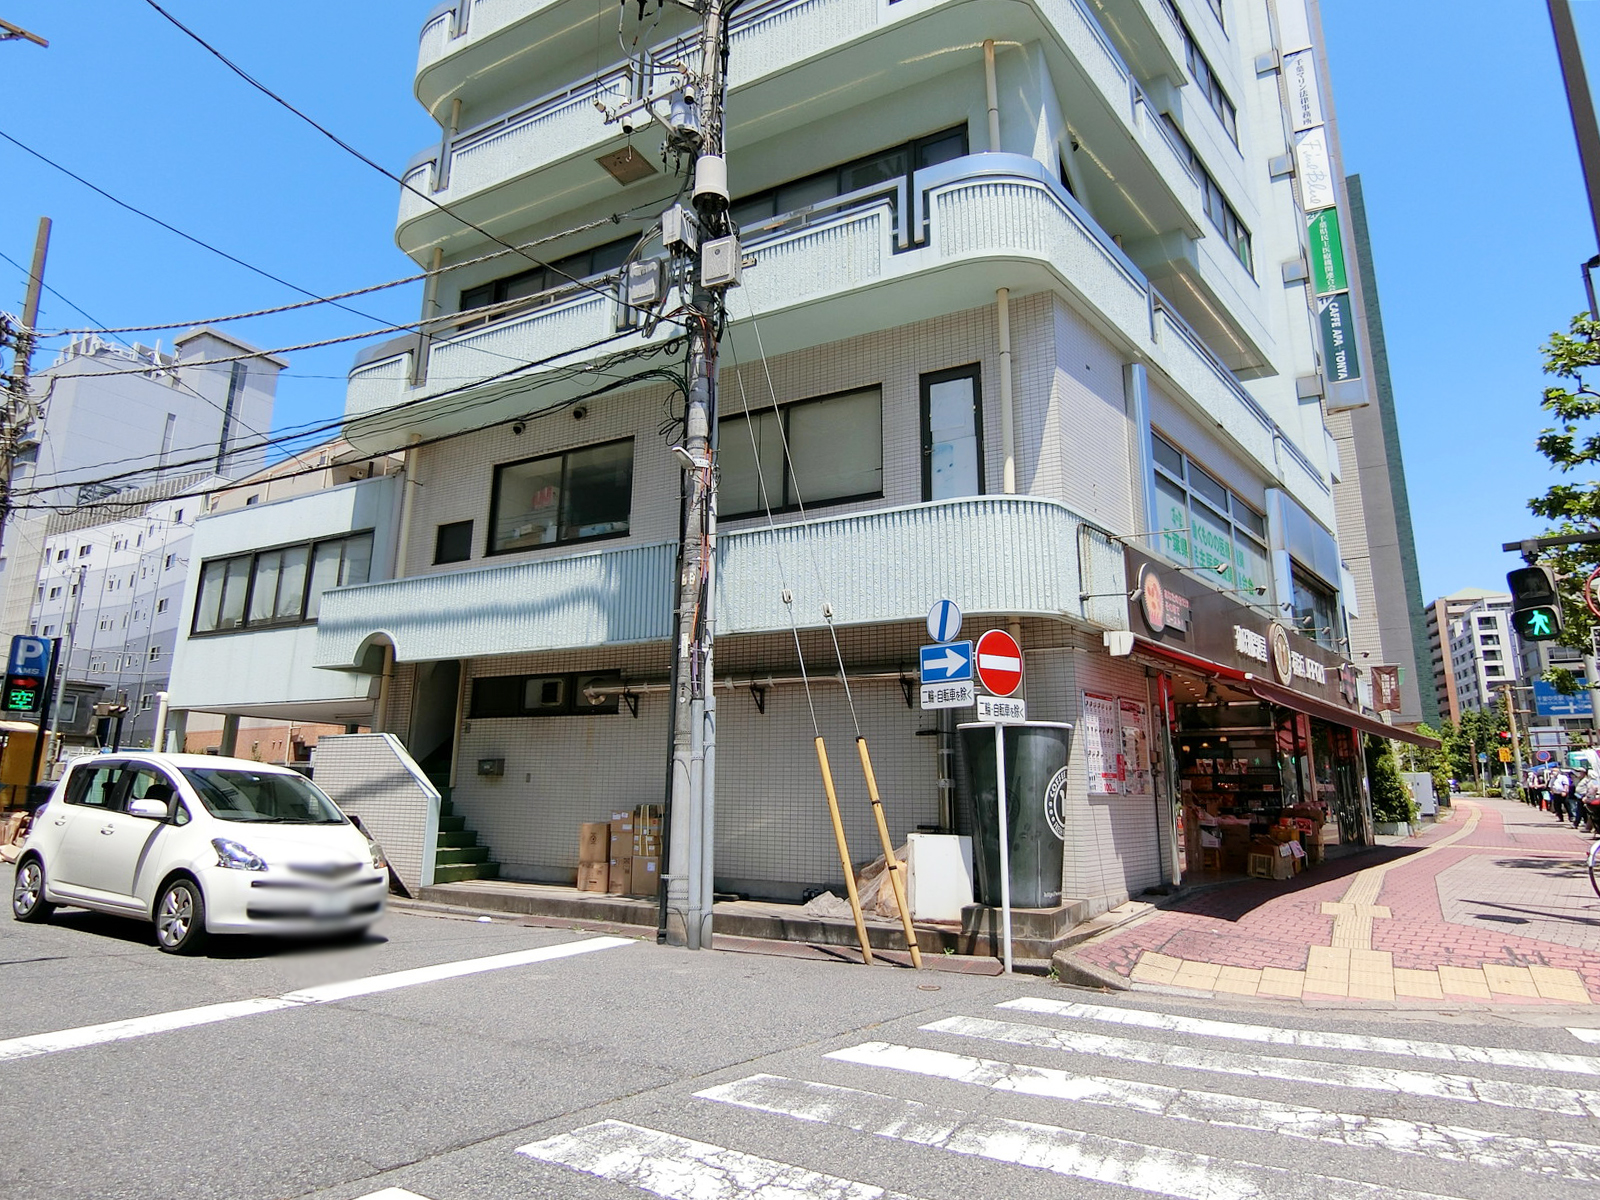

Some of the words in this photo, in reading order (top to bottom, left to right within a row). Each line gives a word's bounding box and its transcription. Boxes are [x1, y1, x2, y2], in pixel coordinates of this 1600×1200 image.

[1328, 302, 1342, 328] CAFFE
[1331, 329, 1344, 347] APA
[1334, 350, 1348, 380] TONYA
[15, 638, 44, 666] P
[9, 690, 34, 710] 空
